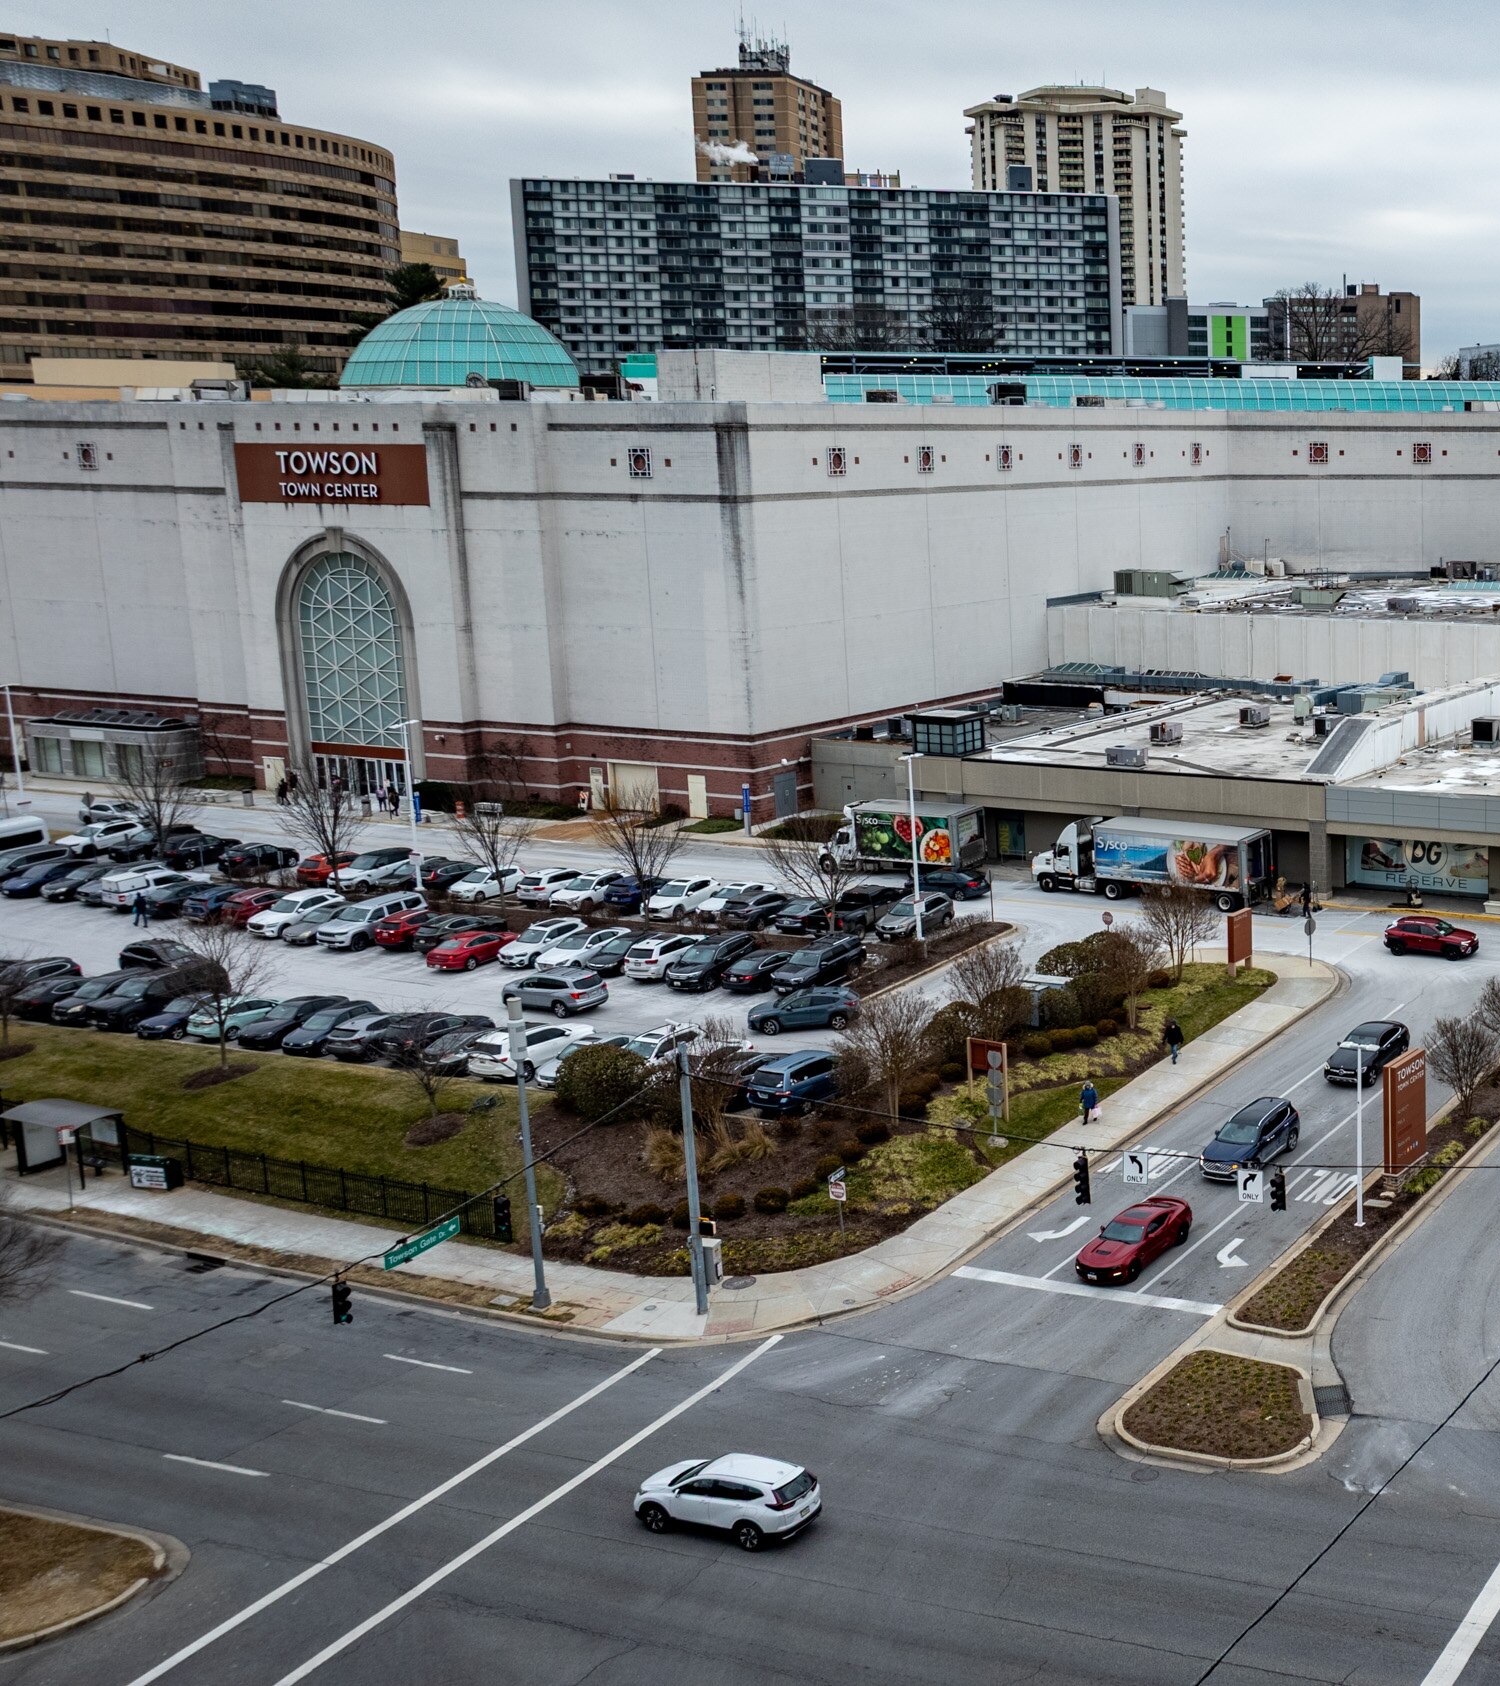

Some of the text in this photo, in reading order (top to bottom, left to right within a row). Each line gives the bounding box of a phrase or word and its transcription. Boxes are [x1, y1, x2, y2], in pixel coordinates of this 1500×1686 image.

[275, 451, 377, 475] TOWSON
[279, 482, 378, 498] TOWN CENTER
[1411, 840, 1442, 865] DG
[1385, 872, 1468, 889] RESERVE
[1397, 1056, 1425, 1081] TOWSON
[1397, 1069, 1425, 1092] TOWN CENTER
[1242, 1192, 1259, 1200] ONLY
[388, 1246, 418, 1264] Towson
[420, 1235, 437, 1249] Gate
